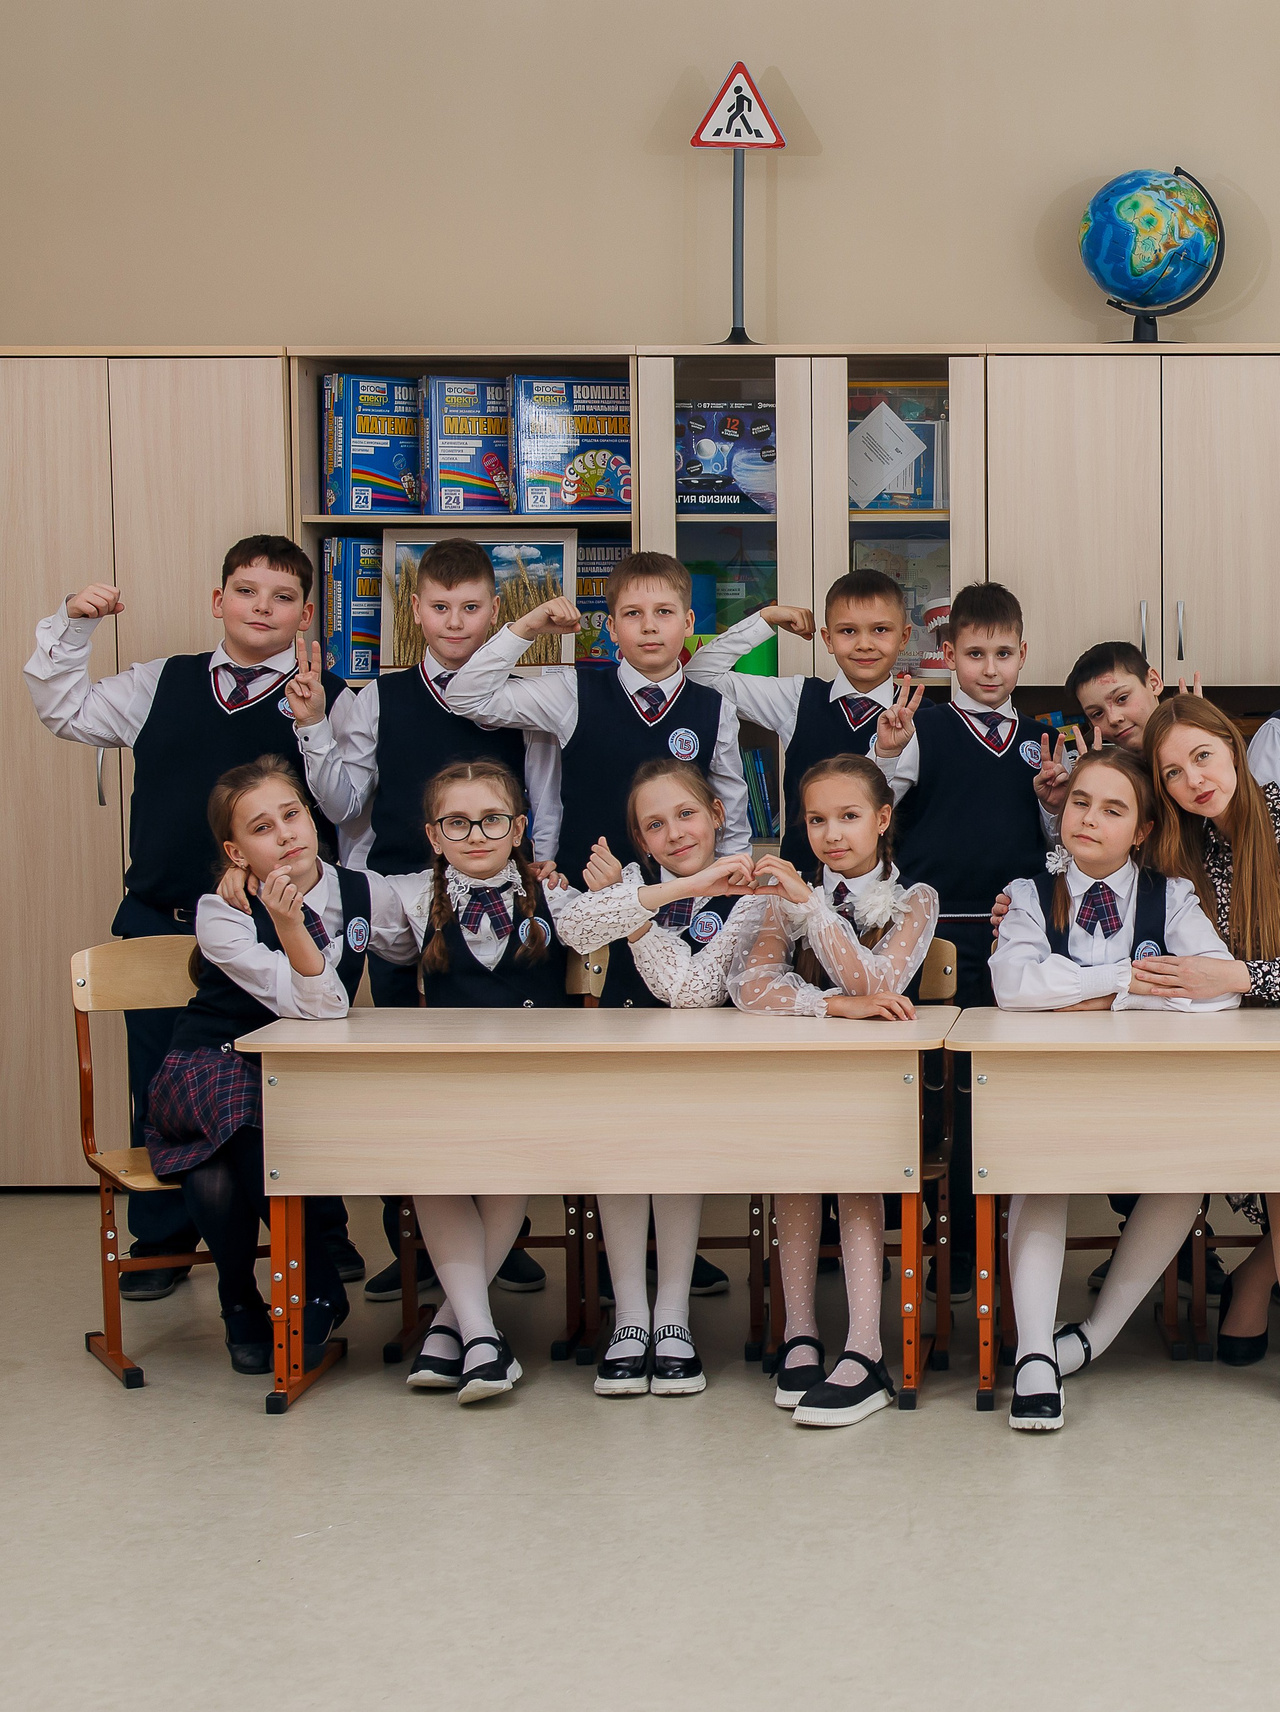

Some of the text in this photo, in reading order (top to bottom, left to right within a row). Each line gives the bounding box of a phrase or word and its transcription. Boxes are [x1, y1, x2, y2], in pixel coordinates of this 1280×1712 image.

[726, 417, 740, 430] 12
[355, 495, 369, 505] 24
[445, 496, 460, 505] 24
[533, 496, 546, 504] 24
[698, 495, 740, 503] ФИЗИКИ
[356, 658, 369, 667] 24
[678, 738, 691, 751] 15
[700, 921, 713, 933] 15
[354, 929, 364, 941] 15
